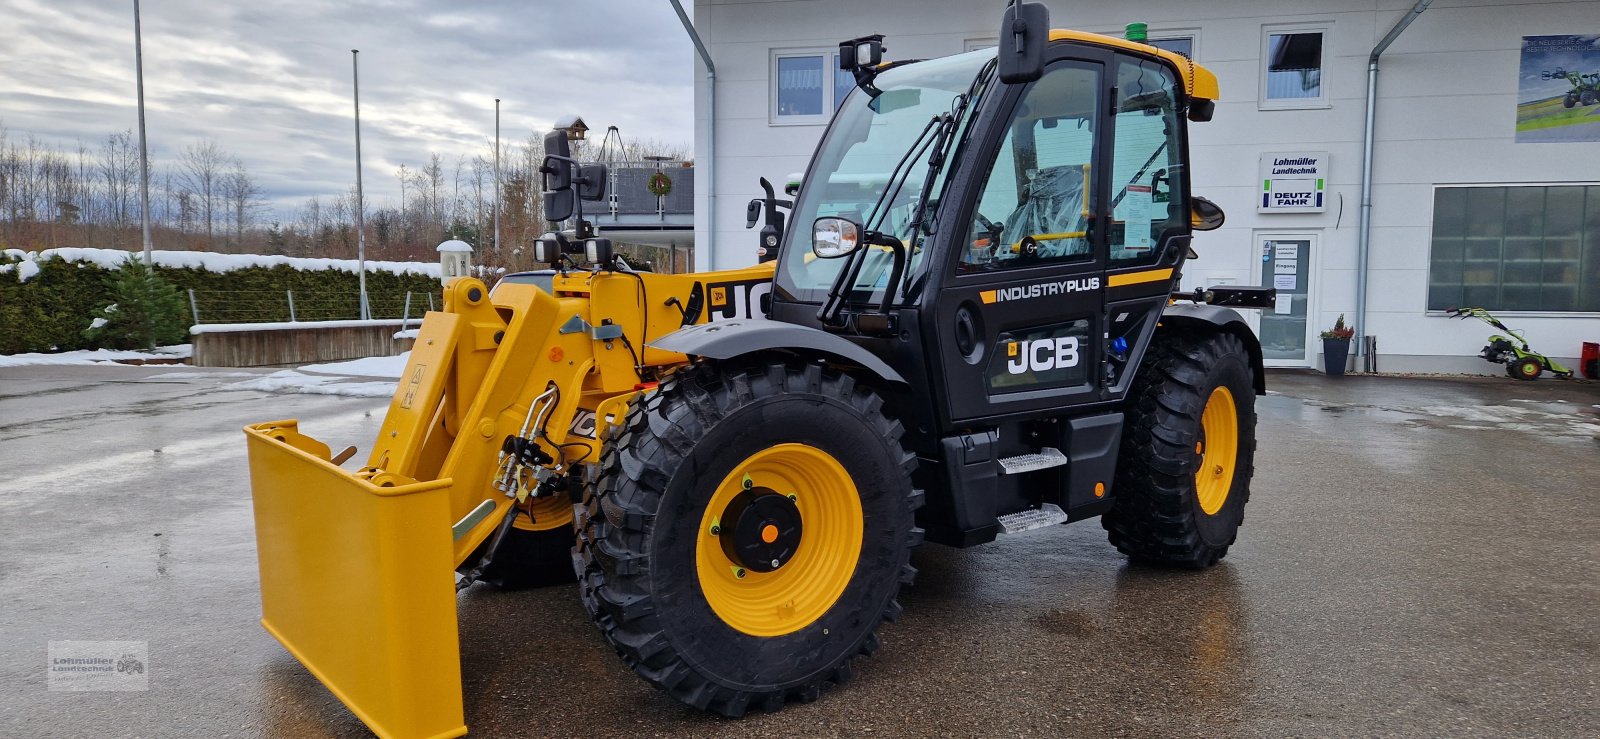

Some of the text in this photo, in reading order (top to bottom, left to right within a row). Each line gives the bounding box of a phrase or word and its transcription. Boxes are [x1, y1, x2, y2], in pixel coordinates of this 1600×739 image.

[1272, 167, 1317, 175] Landtechnik
[1273, 157, 1317, 166] Lohmüller
[711, 282, 772, 321] JC
[1007, 336, 1079, 375] JCB
